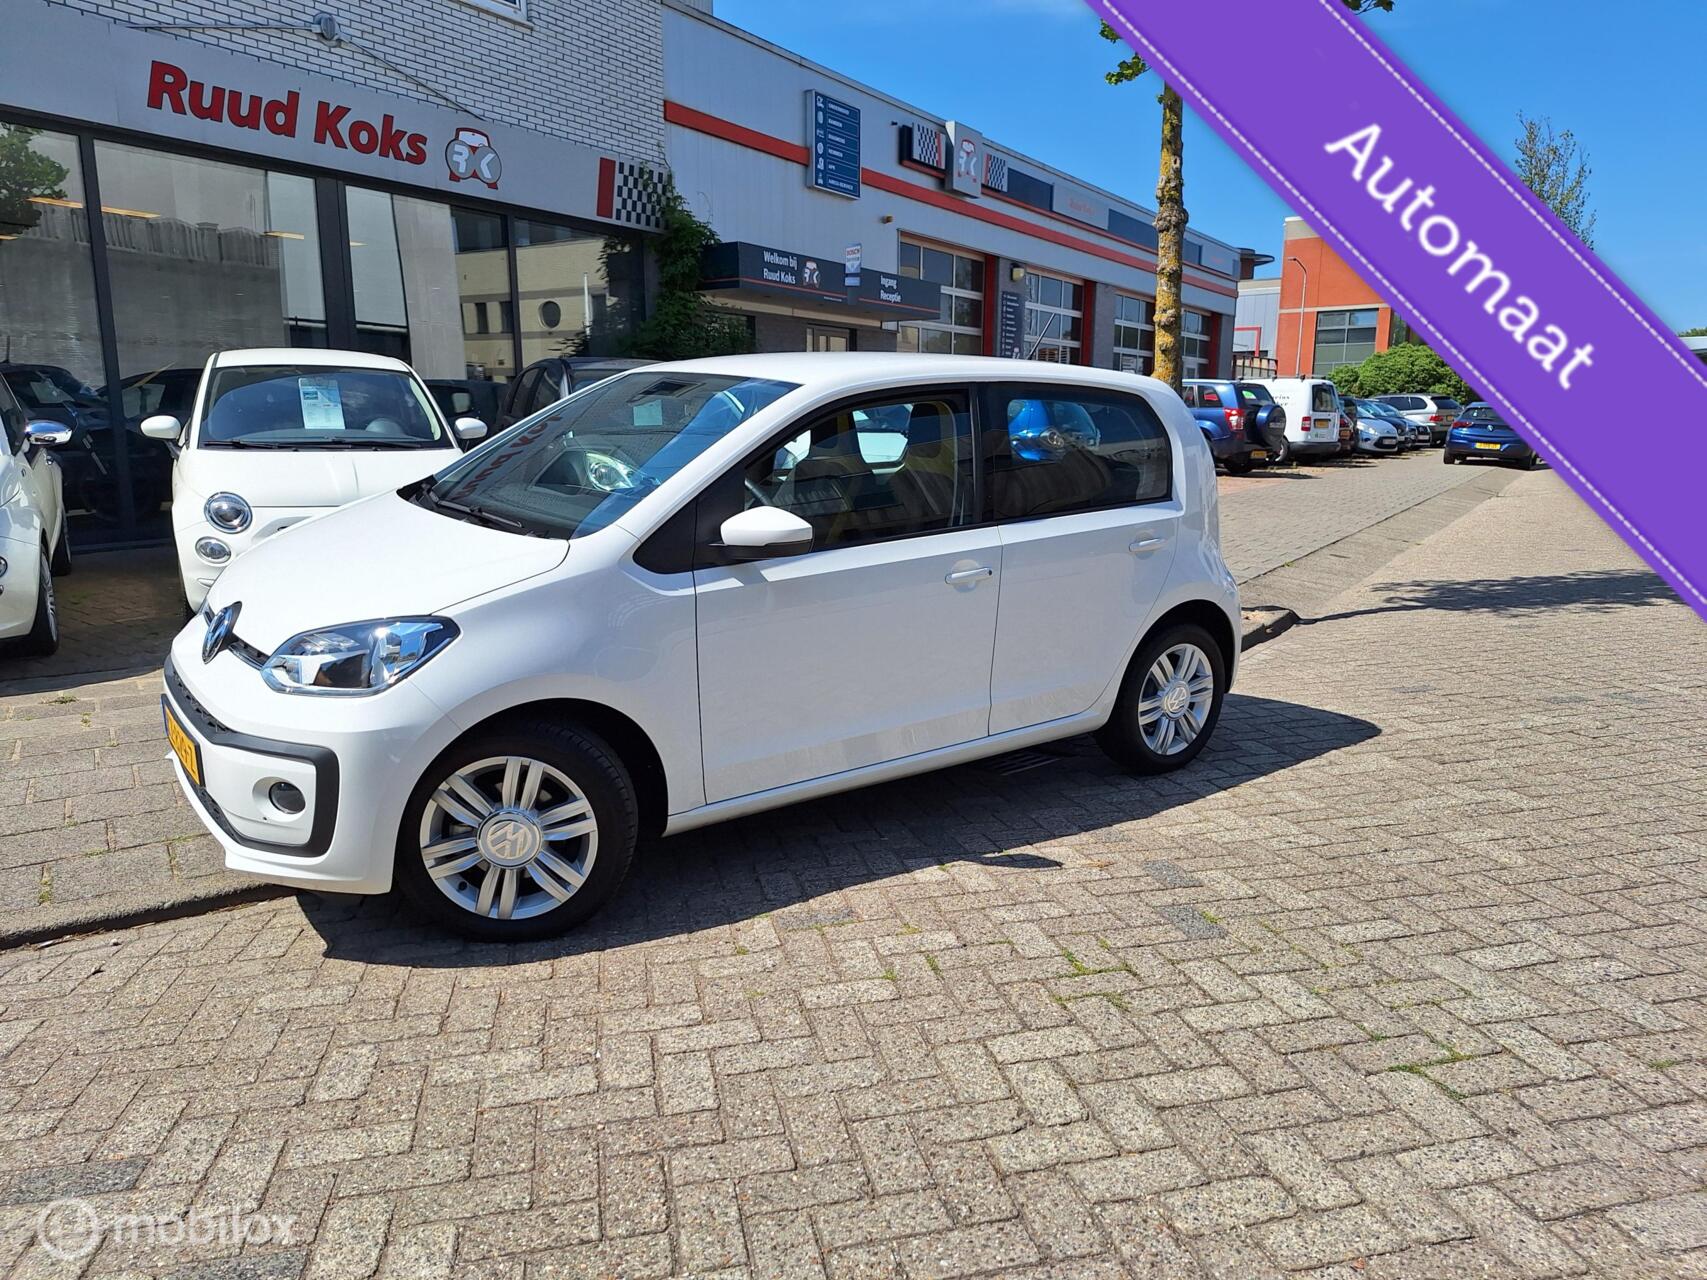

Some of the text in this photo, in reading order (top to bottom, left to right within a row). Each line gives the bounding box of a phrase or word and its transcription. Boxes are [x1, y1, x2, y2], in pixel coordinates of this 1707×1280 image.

[146, 60, 428, 165] Ruud Koks
[763, 250, 798, 271] Welkom bij
[763, 268, 796, 284] Ruud Koks
[880, 274, 898, 290] Ingang
[880, 289, 902, 303] Receptie
